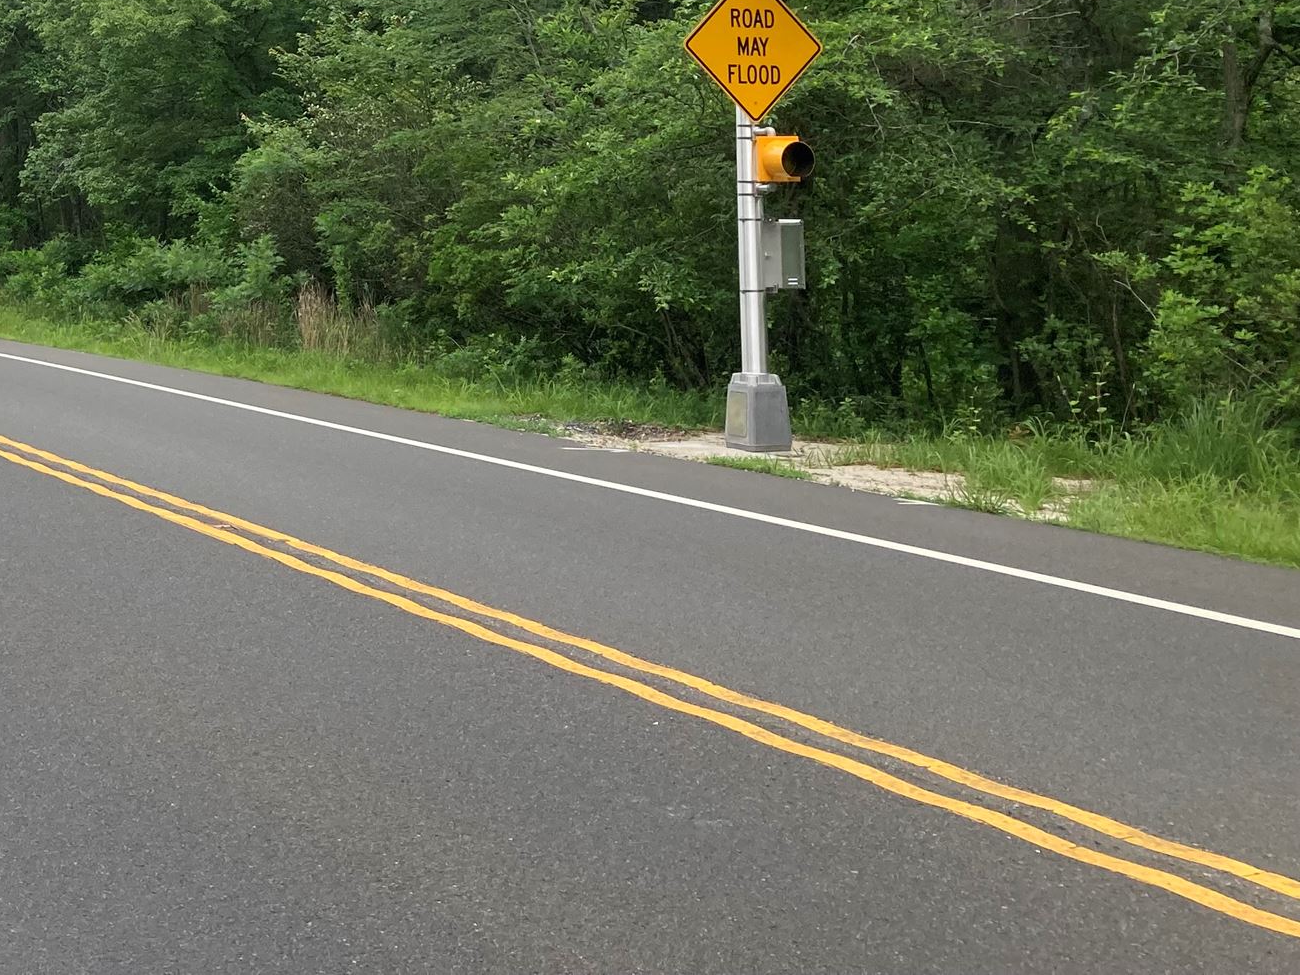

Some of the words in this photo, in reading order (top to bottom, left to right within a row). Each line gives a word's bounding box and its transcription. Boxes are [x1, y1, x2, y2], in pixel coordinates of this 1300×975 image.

[730, 8, 775, 28] ROAD
[737, 36, 769, 56] MAY
[728, 64, 780, 85] FLOOD
